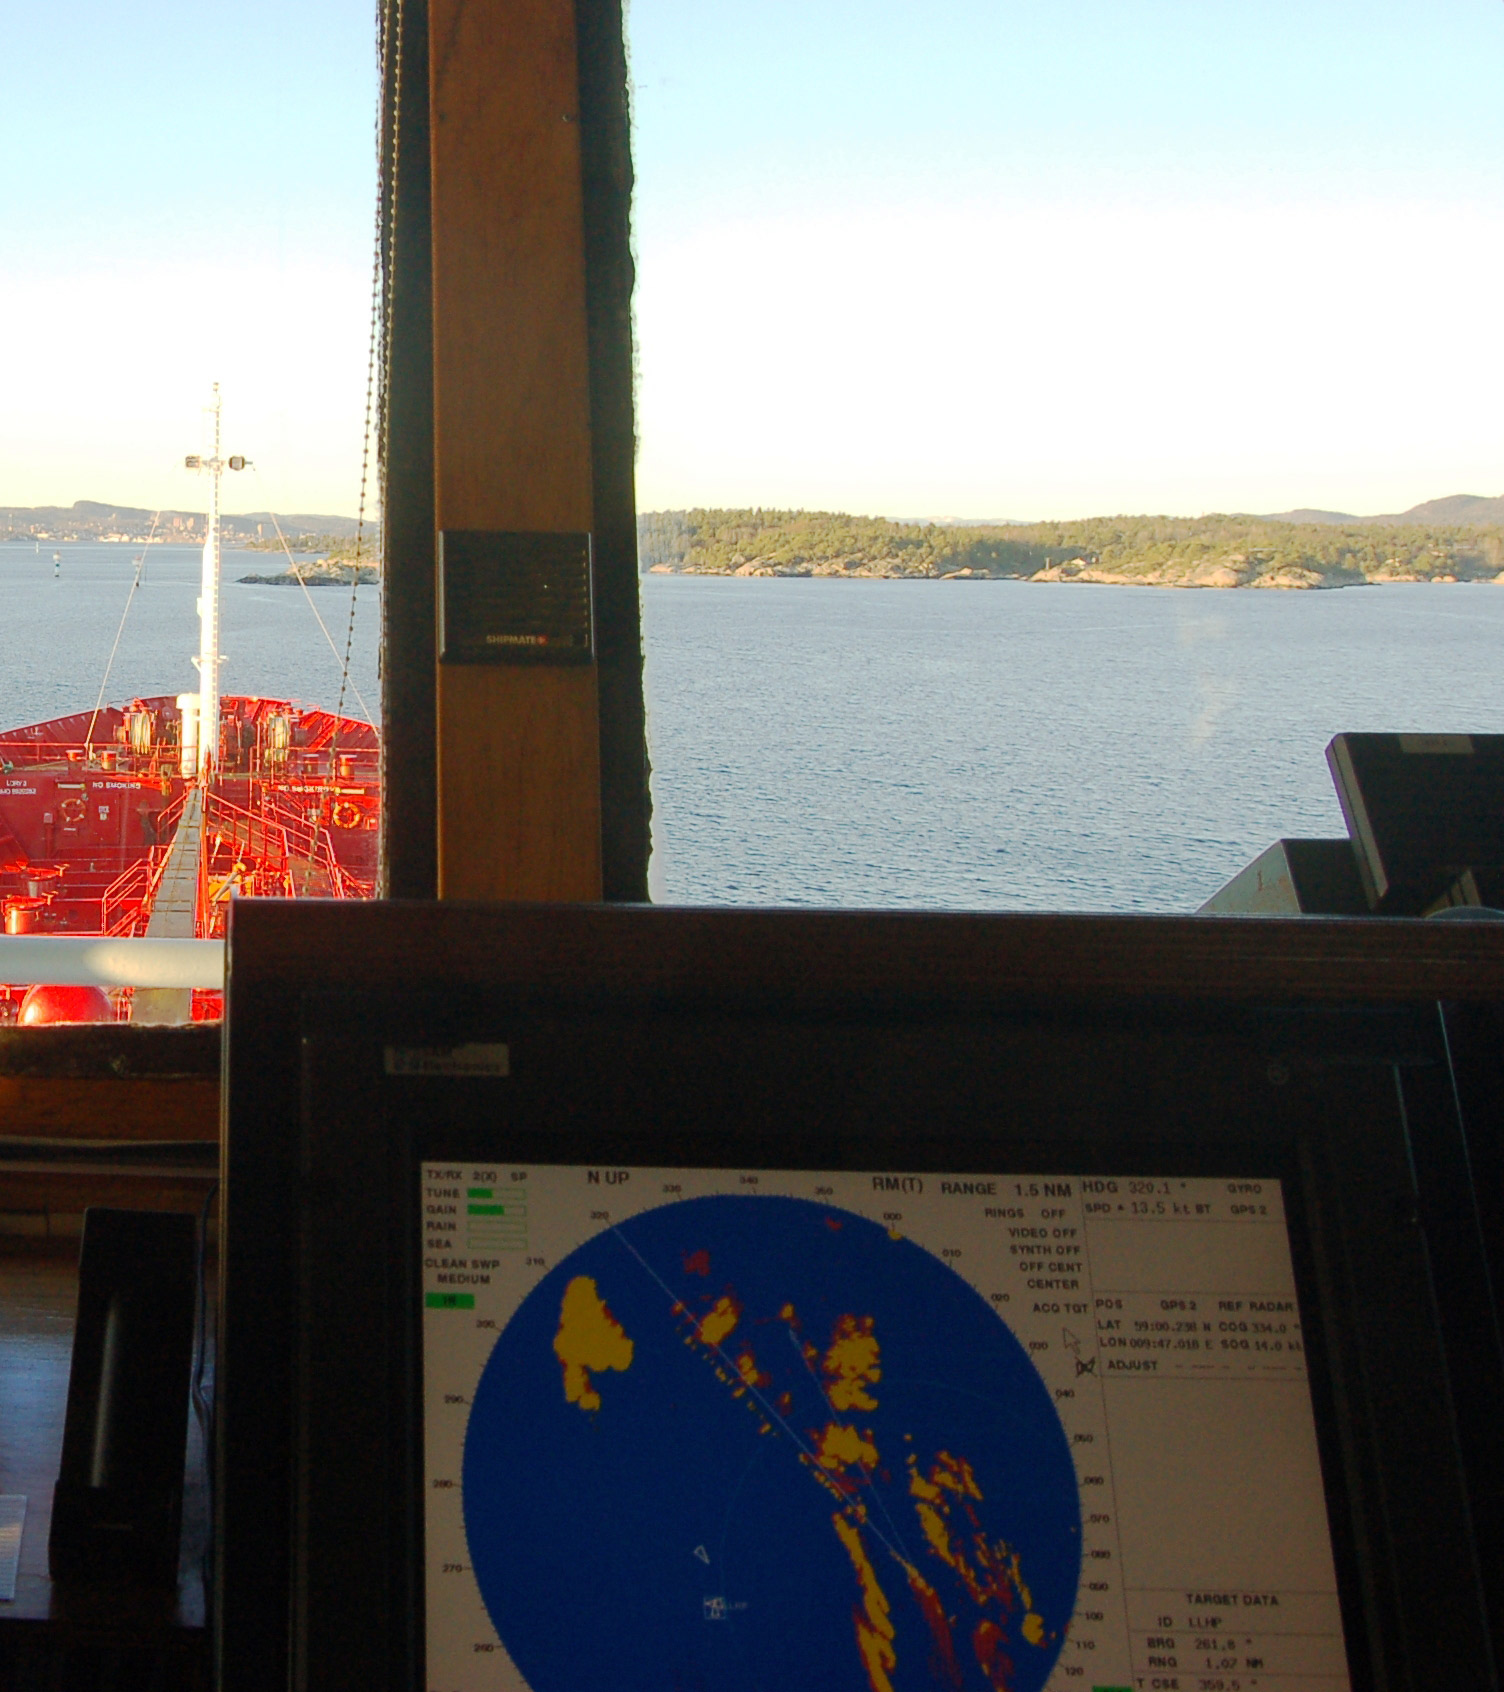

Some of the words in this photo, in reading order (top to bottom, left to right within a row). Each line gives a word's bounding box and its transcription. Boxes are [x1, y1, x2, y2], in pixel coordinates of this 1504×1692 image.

[485, 634, 536, 646] SHIPMATE
[106, 782, 141, 790] SMOKING
[588, 1171, 599, 1184] N
[605, 1171, 629, 1184] UP
[872, 1177, 923, 1194] RM(T)
[941, 1181, 997, 1195] RANGE
[1014, 1183, 1039, 1197] 1.5
[1044, 1183, 1072, 1197] NM
[1082, 1181, 1119, 1194] HDG
[1227, 1184, 1262, 1194] GYRO
[426, 1188, 460, 1198] TUNE
[426, 1205, 457, 1215] GAIN
[984, 1208, 1025, 1218] RINGS
[1041, 1209, 1066, 1218] OFF
[1230, 1204, 1256, 1215] GPS
[426, 1221, 457, 1231] RAIN
[1008, 1228, 1048, 1238] VIDEO
[1052, 1228, 1078, 1239] OFF
[427, 1238, 452, 1249] SEA
[942, 1249, 962, 1257] 010
[1010, 1245, 1052, 1255] SYNTH
[1056, 1245, 1081, 1255] OFF
[424, 1259, 467, 1269] CLEAN
[471, 1259, 500, 1269] SWP
[1019, 1262, 1044, 1272] OFF
[1048, 1262, 1083, 1272] CENT
[437, 1273, 491, 1284] MEDIUM
[1027, 1279, 1079, 1290] CENTER
[1033, 1303, 1060, 1314] ACQ
[1095, 1299, 1123, 1309] POS
[1160, 1300, 1186, 1310] GPS
[1218, 1301, 1243, 1311] REF
[1249, 1301, 1294, 1312] RADAR
[1097, 1320, 1121, 1330] LAT
[1218, 1321, 1248, 1332] COG
[1099, 1337, 1126, 1347] LON
[1220, 1339, 1250, 1350] SOG
[1107, 1360, 1158, 1371] ADJUST
[1186, 1593, 1238, 1606] TARGET
[1243, 1594, 1279, 1606] DATA
[1158, 1617, 1173, 1628] ID
[1147, 1637, 1175, 1649] BRG
[1148, 1657, 1178, 1668] RNG
[1136, 1678, 1145, 1688] T
[1152, 1678, 1179, 1689] CSE
